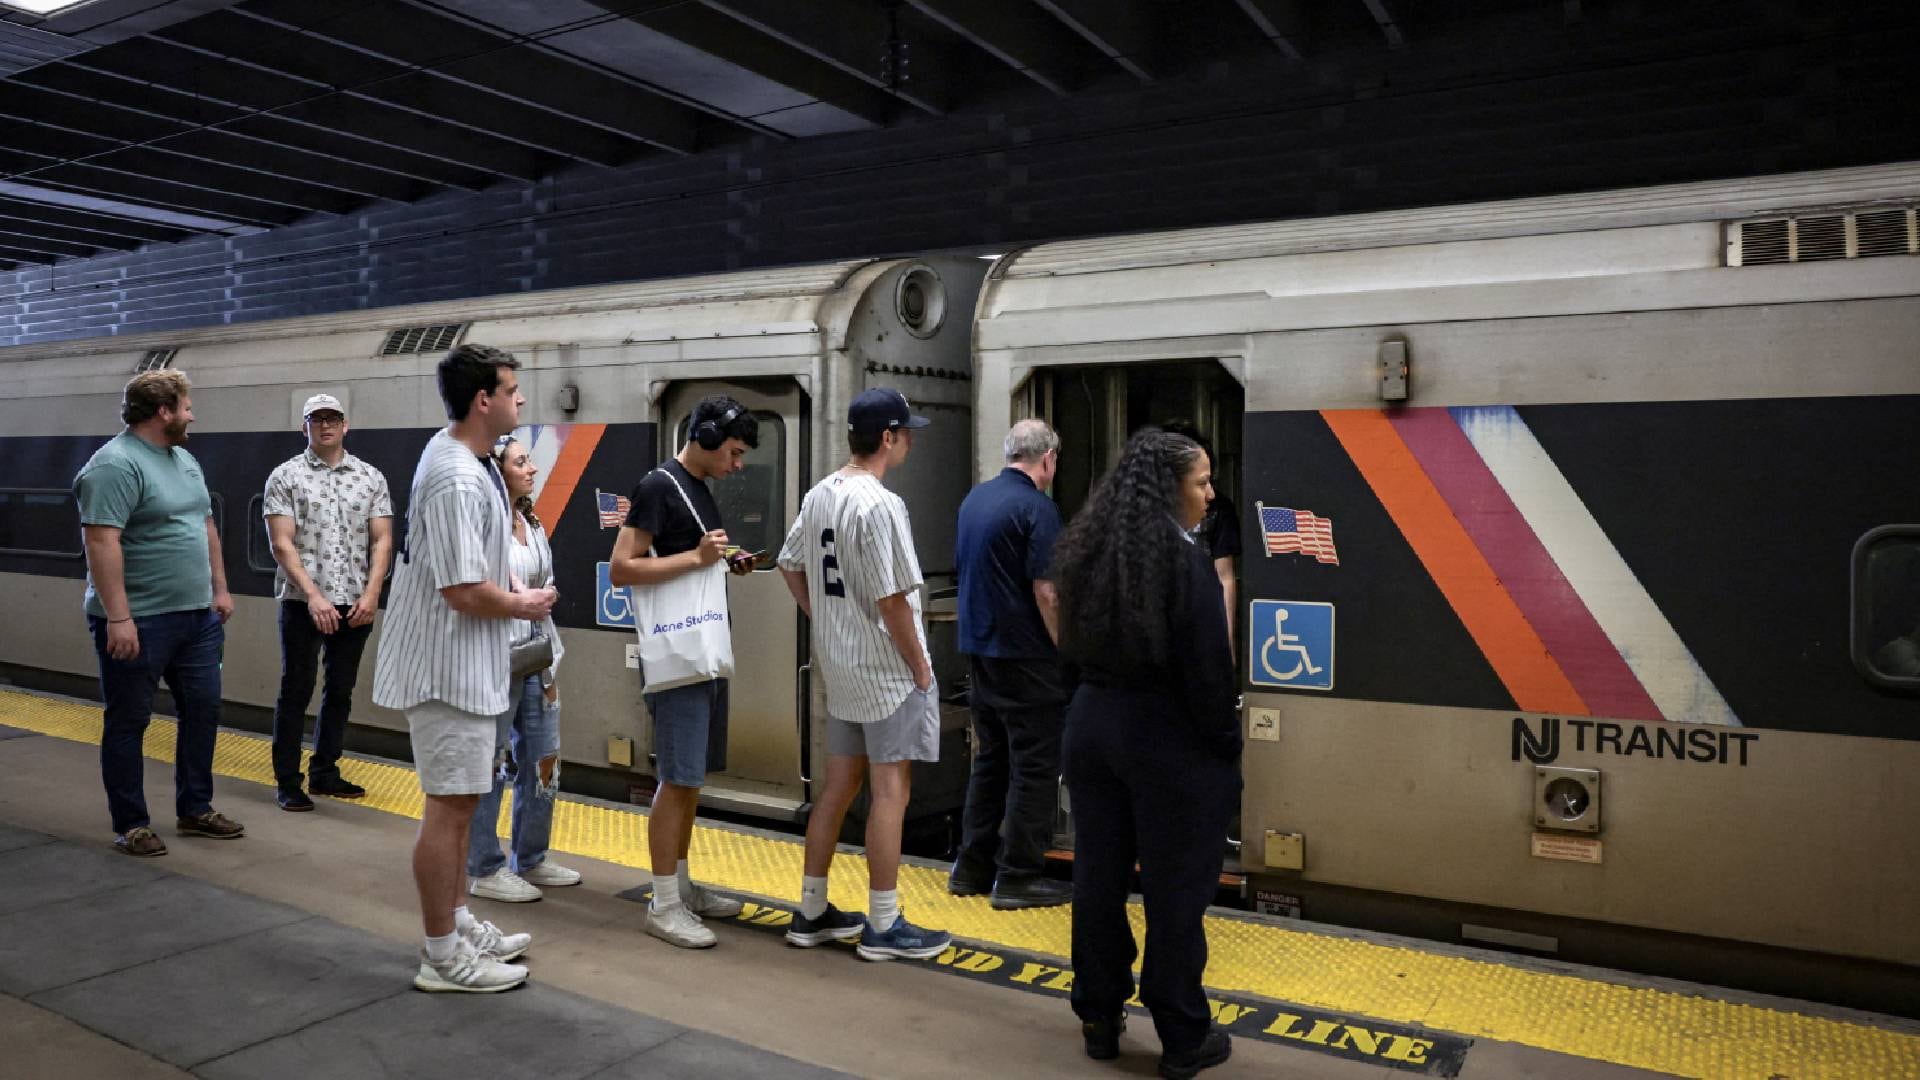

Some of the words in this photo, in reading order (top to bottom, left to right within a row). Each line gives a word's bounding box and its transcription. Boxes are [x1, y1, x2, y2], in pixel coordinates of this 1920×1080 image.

[821, 528, 845, 598] 2
[653, 622, 683, 635] Acne
[685, 610, 723, 628] Studios
[1511, 718, 1560, 764] NJ
[1568, 720, 1759, 765] TRANSIT
[1262, 1012, 1434, 1065] LINE
